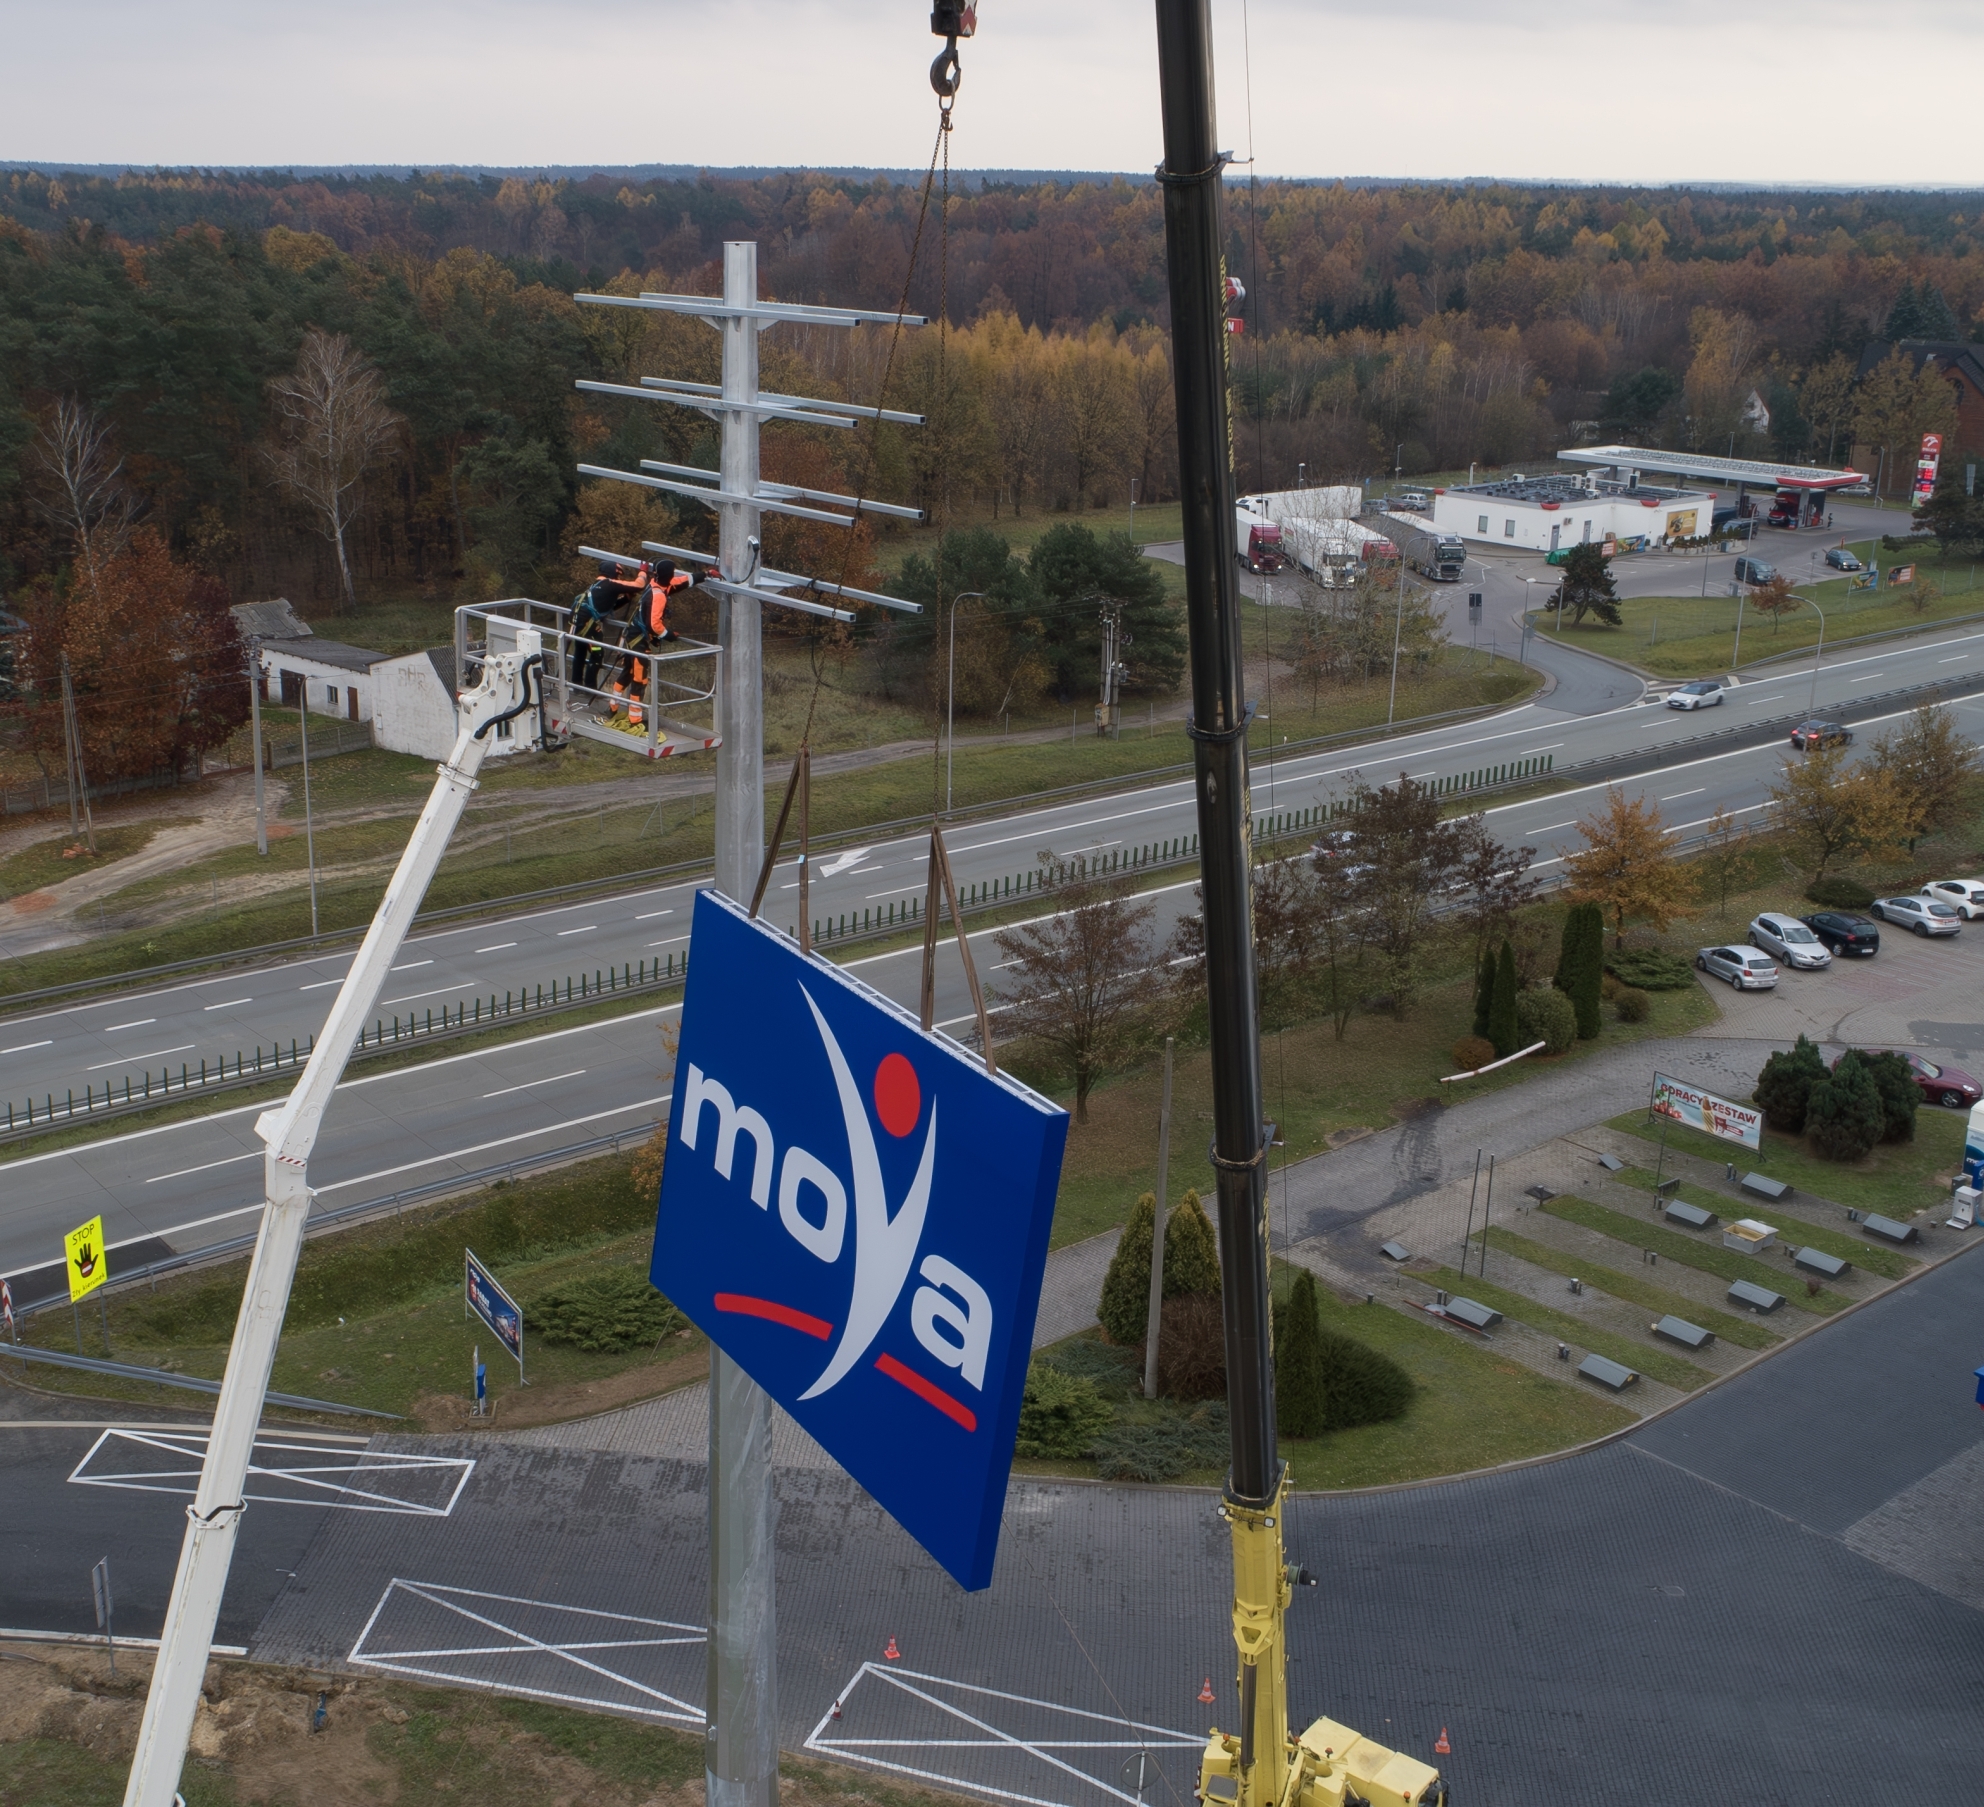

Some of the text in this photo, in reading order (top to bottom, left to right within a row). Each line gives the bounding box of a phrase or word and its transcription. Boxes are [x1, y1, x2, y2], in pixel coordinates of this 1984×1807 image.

[1660, 1083, 1703, 1105] GORĄCY
[1711, 1101, 1757, 1125] ZESTAW
[72, 1223, 95, 1246] STOP
[82, 1272, 105, 1289] kierunek
